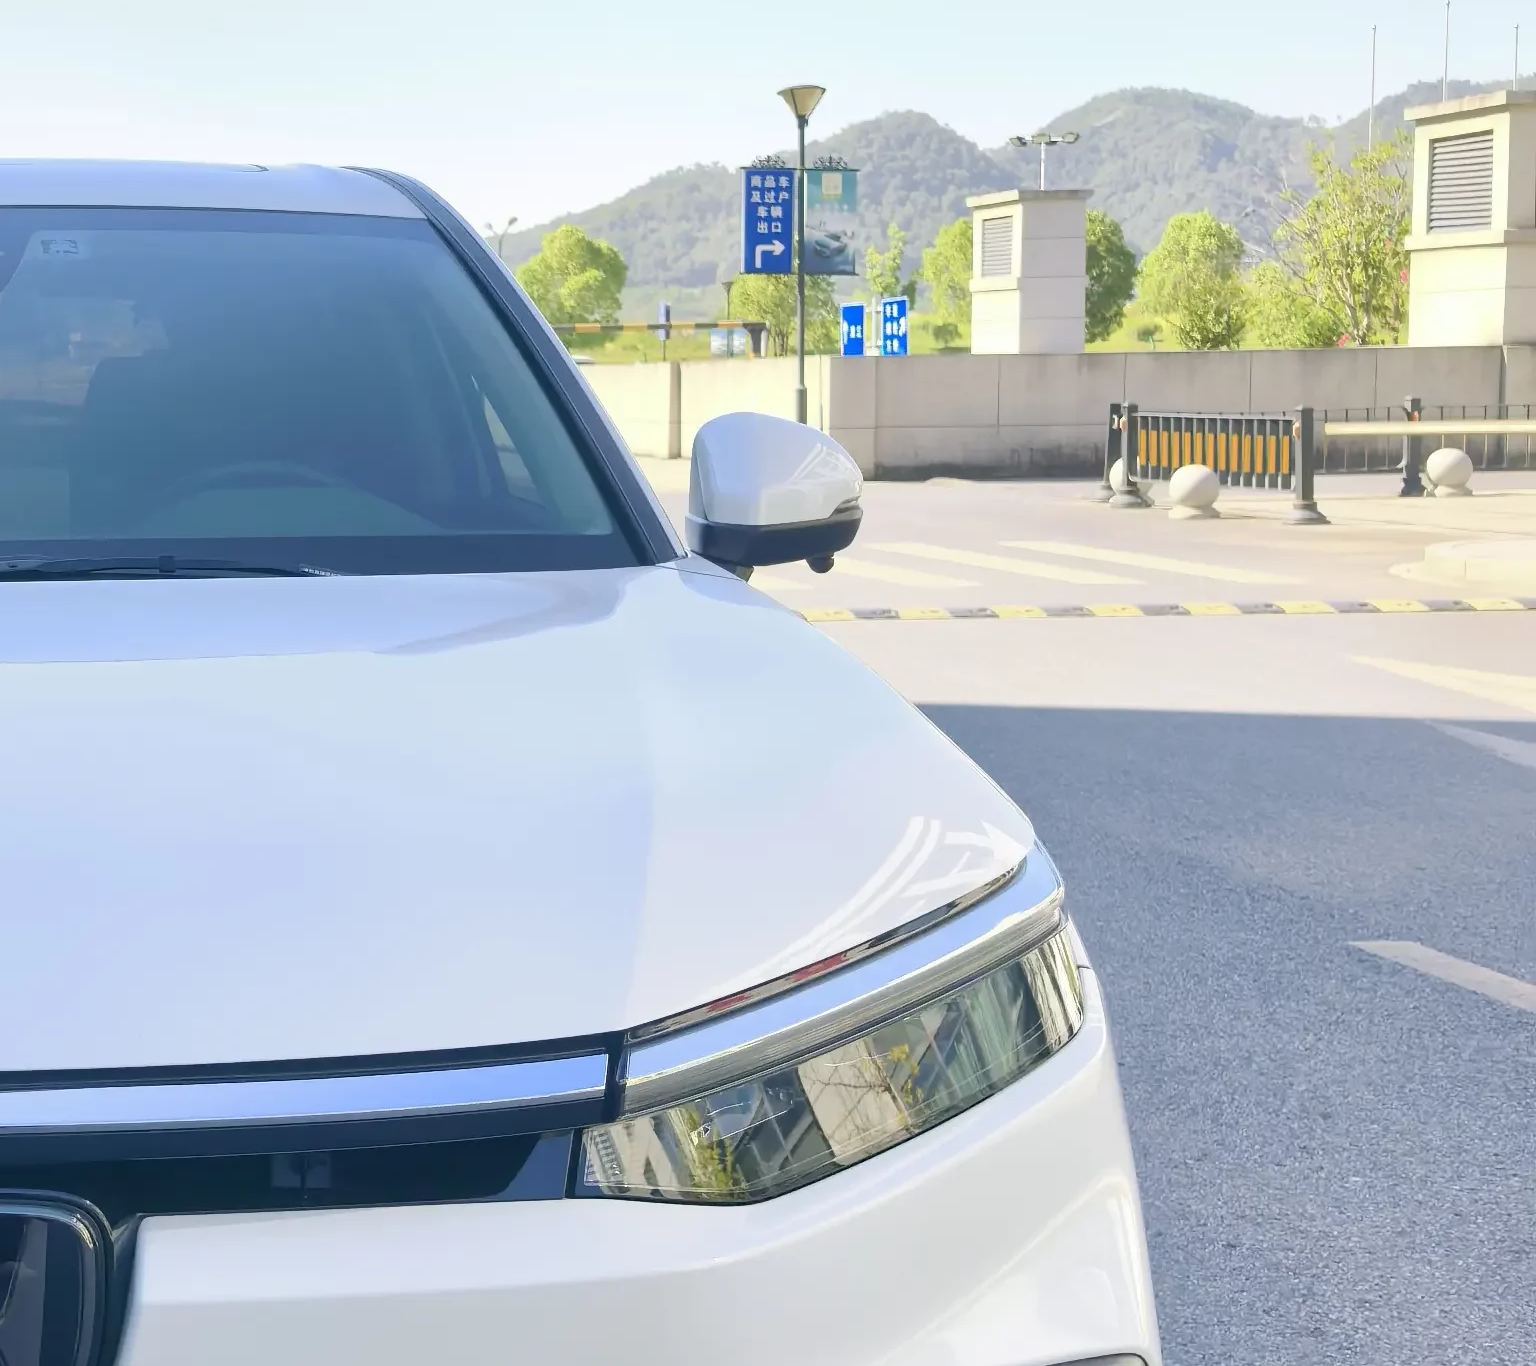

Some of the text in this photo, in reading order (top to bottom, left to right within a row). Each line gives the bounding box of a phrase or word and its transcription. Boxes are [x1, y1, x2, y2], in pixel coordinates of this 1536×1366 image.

[750, 175, 790, 188] 商品车
[757, 220, 782, 233] 出口
